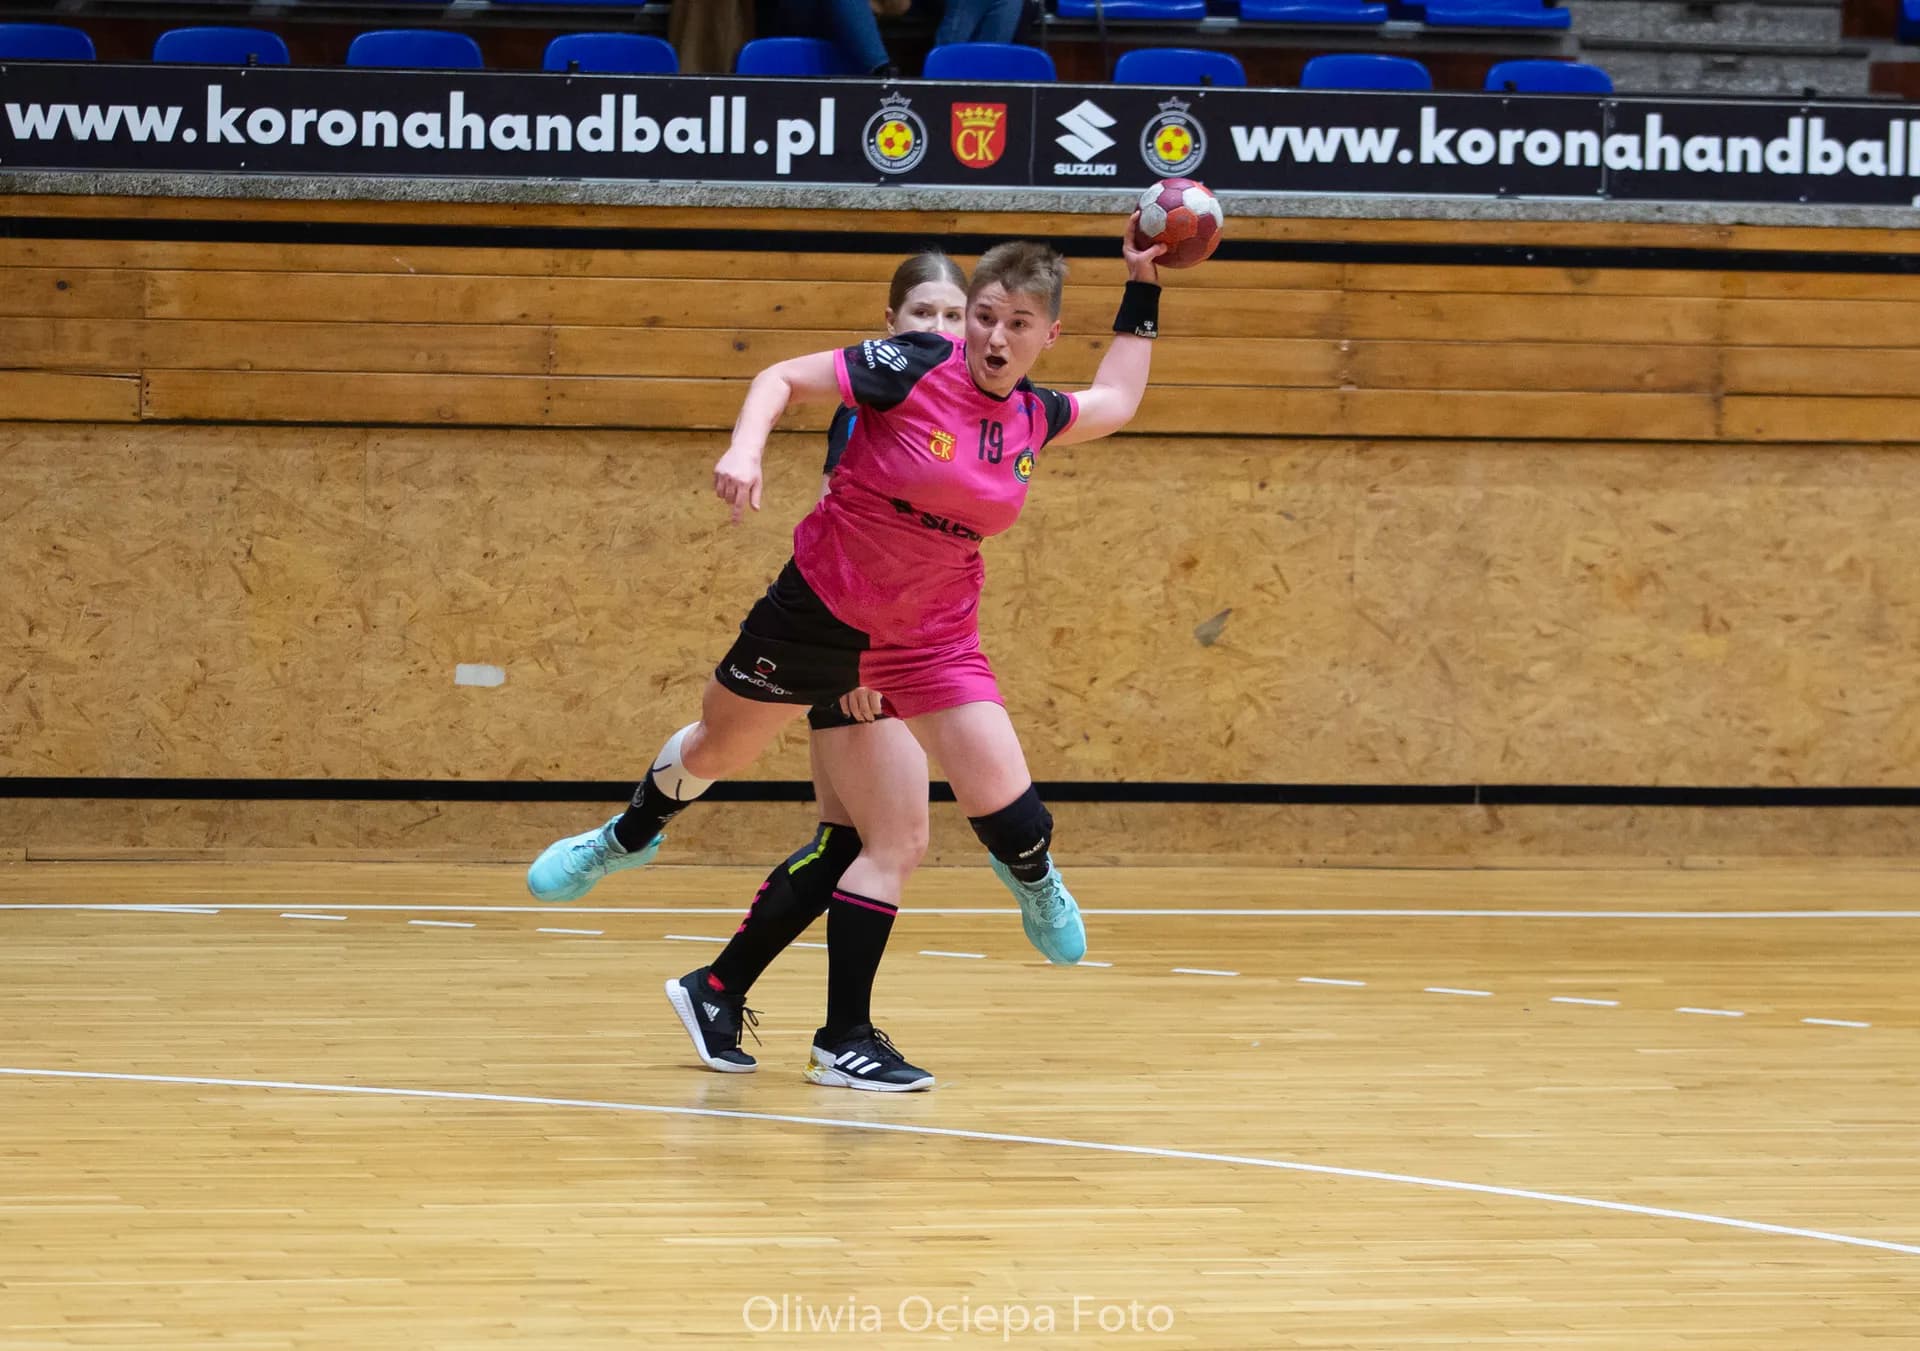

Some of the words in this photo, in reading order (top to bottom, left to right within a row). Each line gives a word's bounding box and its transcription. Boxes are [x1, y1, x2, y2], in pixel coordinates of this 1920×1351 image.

[5, 85, 837, 176] www.koronahandball.pl
[956, 129, 995, 161] CK
[1053, 163, 1117, 176] SUZUKI
[929, 438, 953, 461] CK
[978, 418, 1004, 465] 19
